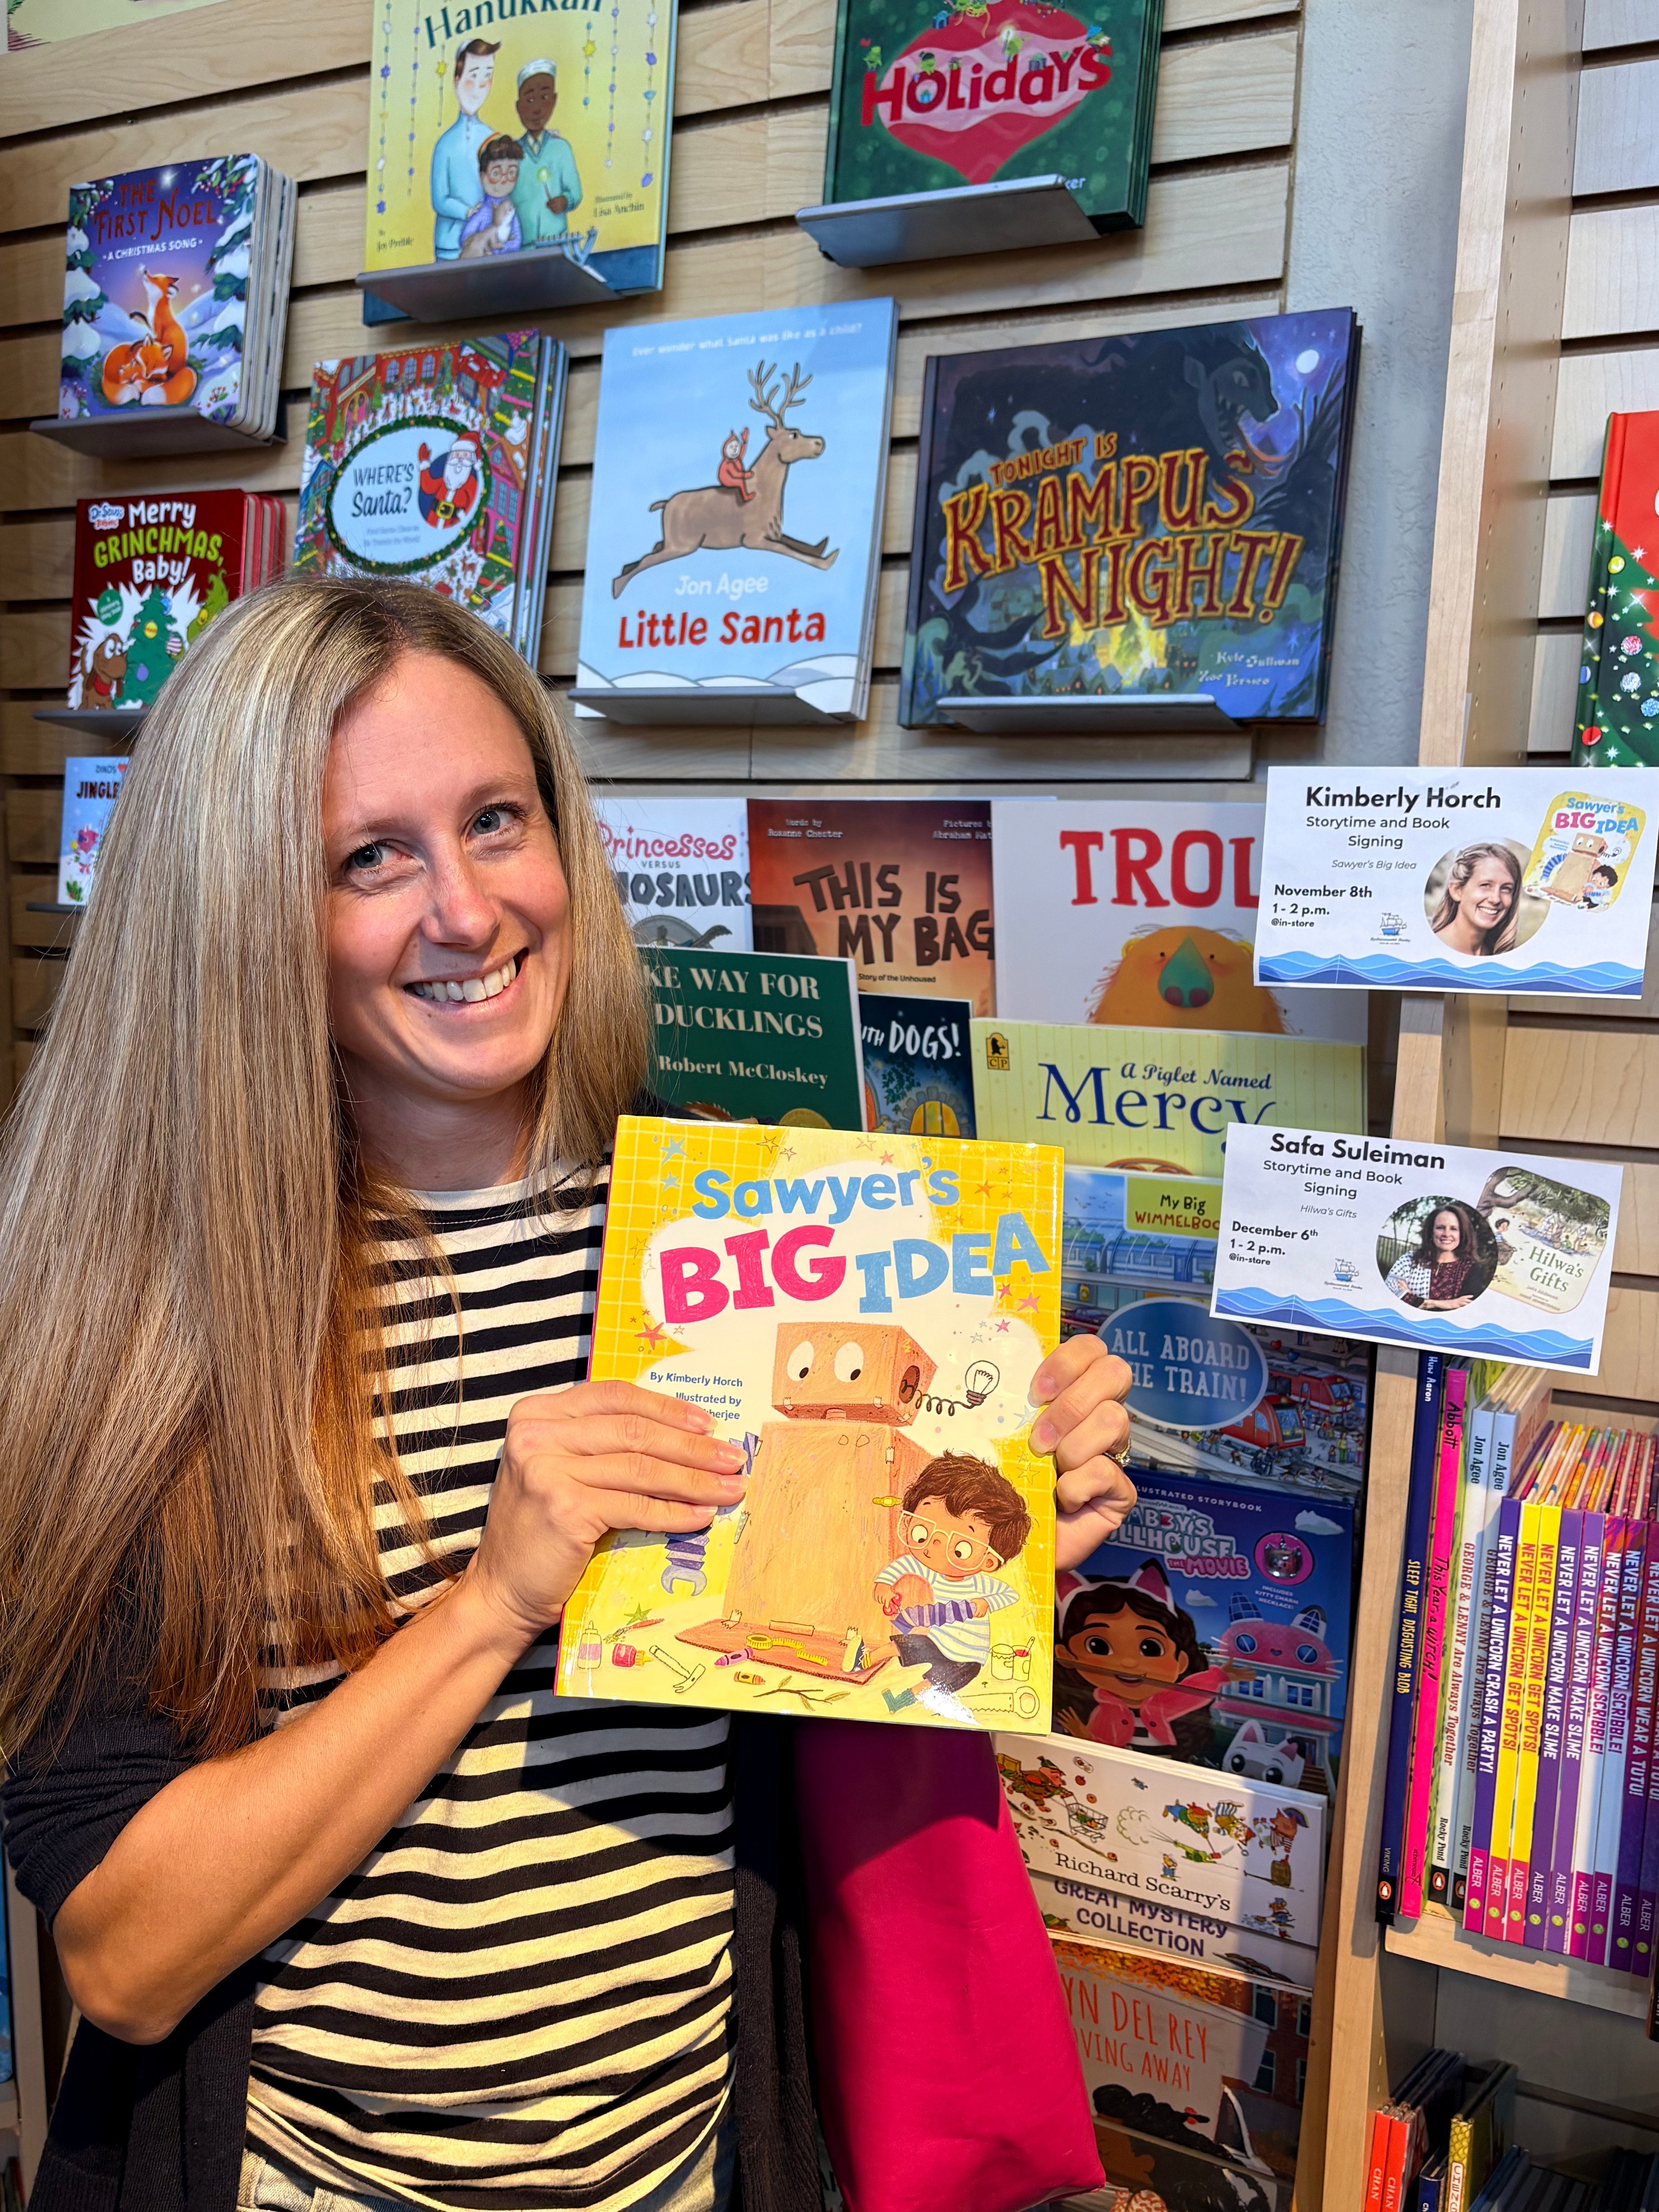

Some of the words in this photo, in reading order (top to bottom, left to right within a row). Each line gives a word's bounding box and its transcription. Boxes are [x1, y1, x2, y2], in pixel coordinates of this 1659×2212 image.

[119, 180, 157, 207] THE
[94, 210, 147, 244] FIRST
[150, 187, 217, 241] NOEL
[115, 243, 167, 259] CHRISTMAS
[168, 238, 197, 251] SONG
[727, 335, 756, 346] Santa
[759, 332, 779, 343] was
[804, 329, 816, 338] as
[989, 440, 1087, 488] TONIGHT
[1094, 432, 1118, 460] IS
[353, 463, 414, 487] WHERE'S
[128, 500, 196, 528] Merry
[351, 487, 412, 518] Santa?
[942, 447, 1256, 594] KRAMPUS
[93, 526, 224, 568] GRINCHMAS,
[132, 554, 191, 585] Baby!
[675, 575, 712, 597] Jon
[716, 573, 769, 601] Agee
[1038, 529, 1304, 641] NIGHT!
[619, 609, 708, 648] Little
[720, 608, 827, 644] Santa
[1306, 787, 1420, 814] Kimberly
[1426, 787, 1501, 810] Horch
[1567, 797, 1625, 814] Sawyer's
[768, 828, 801, 837] Roxanne
[806, 829, 843, 838] Chester
[1306, 816, 1376, 829] Storytime
[1380, 817, 1407, 828] and
[1412, 817, 1450, 829] Book
[1555, 812, 1596, 829] BIG
[1595, 817, 1638, 834] IDEA
[1348, 835, 1403, 849] Signing
[641, 860, 681, 869] VERSUS
[1332, 859, 1374, 870] Sawyer's
[1376, 860, 1392, 871] Big
[1395, 861, 1417, 870] Idea
[793, 861, 902, 912] THIS
[925, 871, 962, 914] IS
[1274, 884, 1346, 898] November
[1350, 886, 1372, 898] 8th
[1271, 918, 1314, 928] @in-store
[1273, 903, 1278, 913] 1
[1289, 903, 1298, 914] 2
[1302, 905, 1330, 917] p.m.
[838, 913, 902, 965] MY
[914, 909, 994, 966] BAG
[690, 967, 750, 994] WAY
[761, 973, 821, 1000] FOR
[858, 973, 877, 982] Story
[655, 1003, 823, 1039] DUCKLINGS
[862, 1026, 885, 1046] ITH
[889, 1020, 961, 1060] DOGS!
[659, 1055, 721, 1075] Robert
[728, 1060, 828, 1088] McCloskey
[1121, 1063, 1137, 1079] A
[1142, 1064, 1196, 1088] Piglet
[1203, 1069, 1272, 1090] Named
[1036, 1063, 1277, 1137] Mercy
[1270, 1133, 1324, 1157] Safa
[1332, 1139, 1445, 1169] Suleiman
[1263, 1160, 1332, 1177] Storytime
[1335, 1169, 1362, 1180] and
[1366, 1171, 1403, 1185] Book
[691, 1155, 960, 1225] Sawyer's
[1304, 1182, 1358, 1200] Signing
[1160, 1194, 1180, 1211] My
[1184, 1195, 1207, 1217] Big
[1301, 1205, 1334, 1216] Hilwa's
[1336, 1209, 1357, 1219] Gifts
[1134, 1211, 1221, 1231] WIMMELBOO
[1232, 1221, 1298, 1239] December
[1301, 1229, 1318, 1241] 6th
[1229, 1252, 1271, 1266] @in-store
[1230, 1239, 1235, 1249] 1
[1246, 1240, 1256, 1252] 2
[1258, 1244, 1286, 1256] p.m.
[659, 1225, 846, 1324] BIG
[856, 1212, 1051, 1314] IDEA
[1529, 1246, 1584, 1278] Hilwa's
[1530, 1267, 1569, 1292] Gifts
[1111, 1327, 1150, 1357] ALL
[1160, 1334, 1250, 1371] ABOARD
[1427, 1356, 1438, 1374] Huw
[650, 1372, 664, 1383] By
[666, 1372, 710, 1386] Kimberly
[713, 1376, 743, 1387] Horch
[1128, 1361, 1154, 1388] HE
[1165, 1364, 1247, 1402] TRAIN!
[1425, 1377, 1436, 1402] Aaron
[676, 1392, 726, 1404] Illustrated
[729, 1396, 742, 1407] by
[1444, 1401, 1462, 1449] Abbott
[1473, 1436, 1486, 1455] Jon
[1470, 1457, 1484, 1484] Agee
[1198, 1496, 1262, 1512] STORYBOOK
[1127, 1505, 1209, 1537] ABBY'S
[1186, 1558, 1249, 1575] MOVIE
[1433, 1556, 1449, 1581] This
[1460, 1543, 1475, 1589] GEORGE
[1496, 1535, 1513, 1576] NEVER
[1406, 1559, 1421, 1585] SLEEP
[1402, 1590, 1419, 1614] TIGHT,
[1494, 1579, 1509, 1602] LET
[1492, 1605, 1507, 1615] A
[1455, 1606, 1469, 1646] LENNY
[1398, 1619, 1416, 1668] DISGUSTING
[1487, 1618, 1505, 1671] UNICORN
[1453, 1648, 1465, 1668] Are
[1397, 1672, 1411, 1694] BLOB
[1448, 1671, 1462, 1712] Always
[1484, 1673, 1501, 1714] CRASH
[1482, 1715, 1497, 1725] A
[1444, 1716, 1459, 1766] Together
[1479, 1729, 1496, 1774] PARTY!
[1437, 1817, 1448, 1841] Rocky
[1383, 1848, 1391, 1872] VIKING
[1437, 1842, 1446, 1861] Pond
[1055, 1853, 1141, 1888] Richard
[1146, 1876, 1231, 1911] Scarry's
[1472, 1856, 1483, 1888] ALBER
[1111, 1991, 1158, 2046] DEL
[1169, 2013, 1207, 2064] REY
[1080, 2028, 1133, 2073] VING
[1141, 2052, 1190, 2092] AWAY
[1371, 2168, 1382, 2200] CHAN
[1386, 2177, 1396, 2209] CHAN
